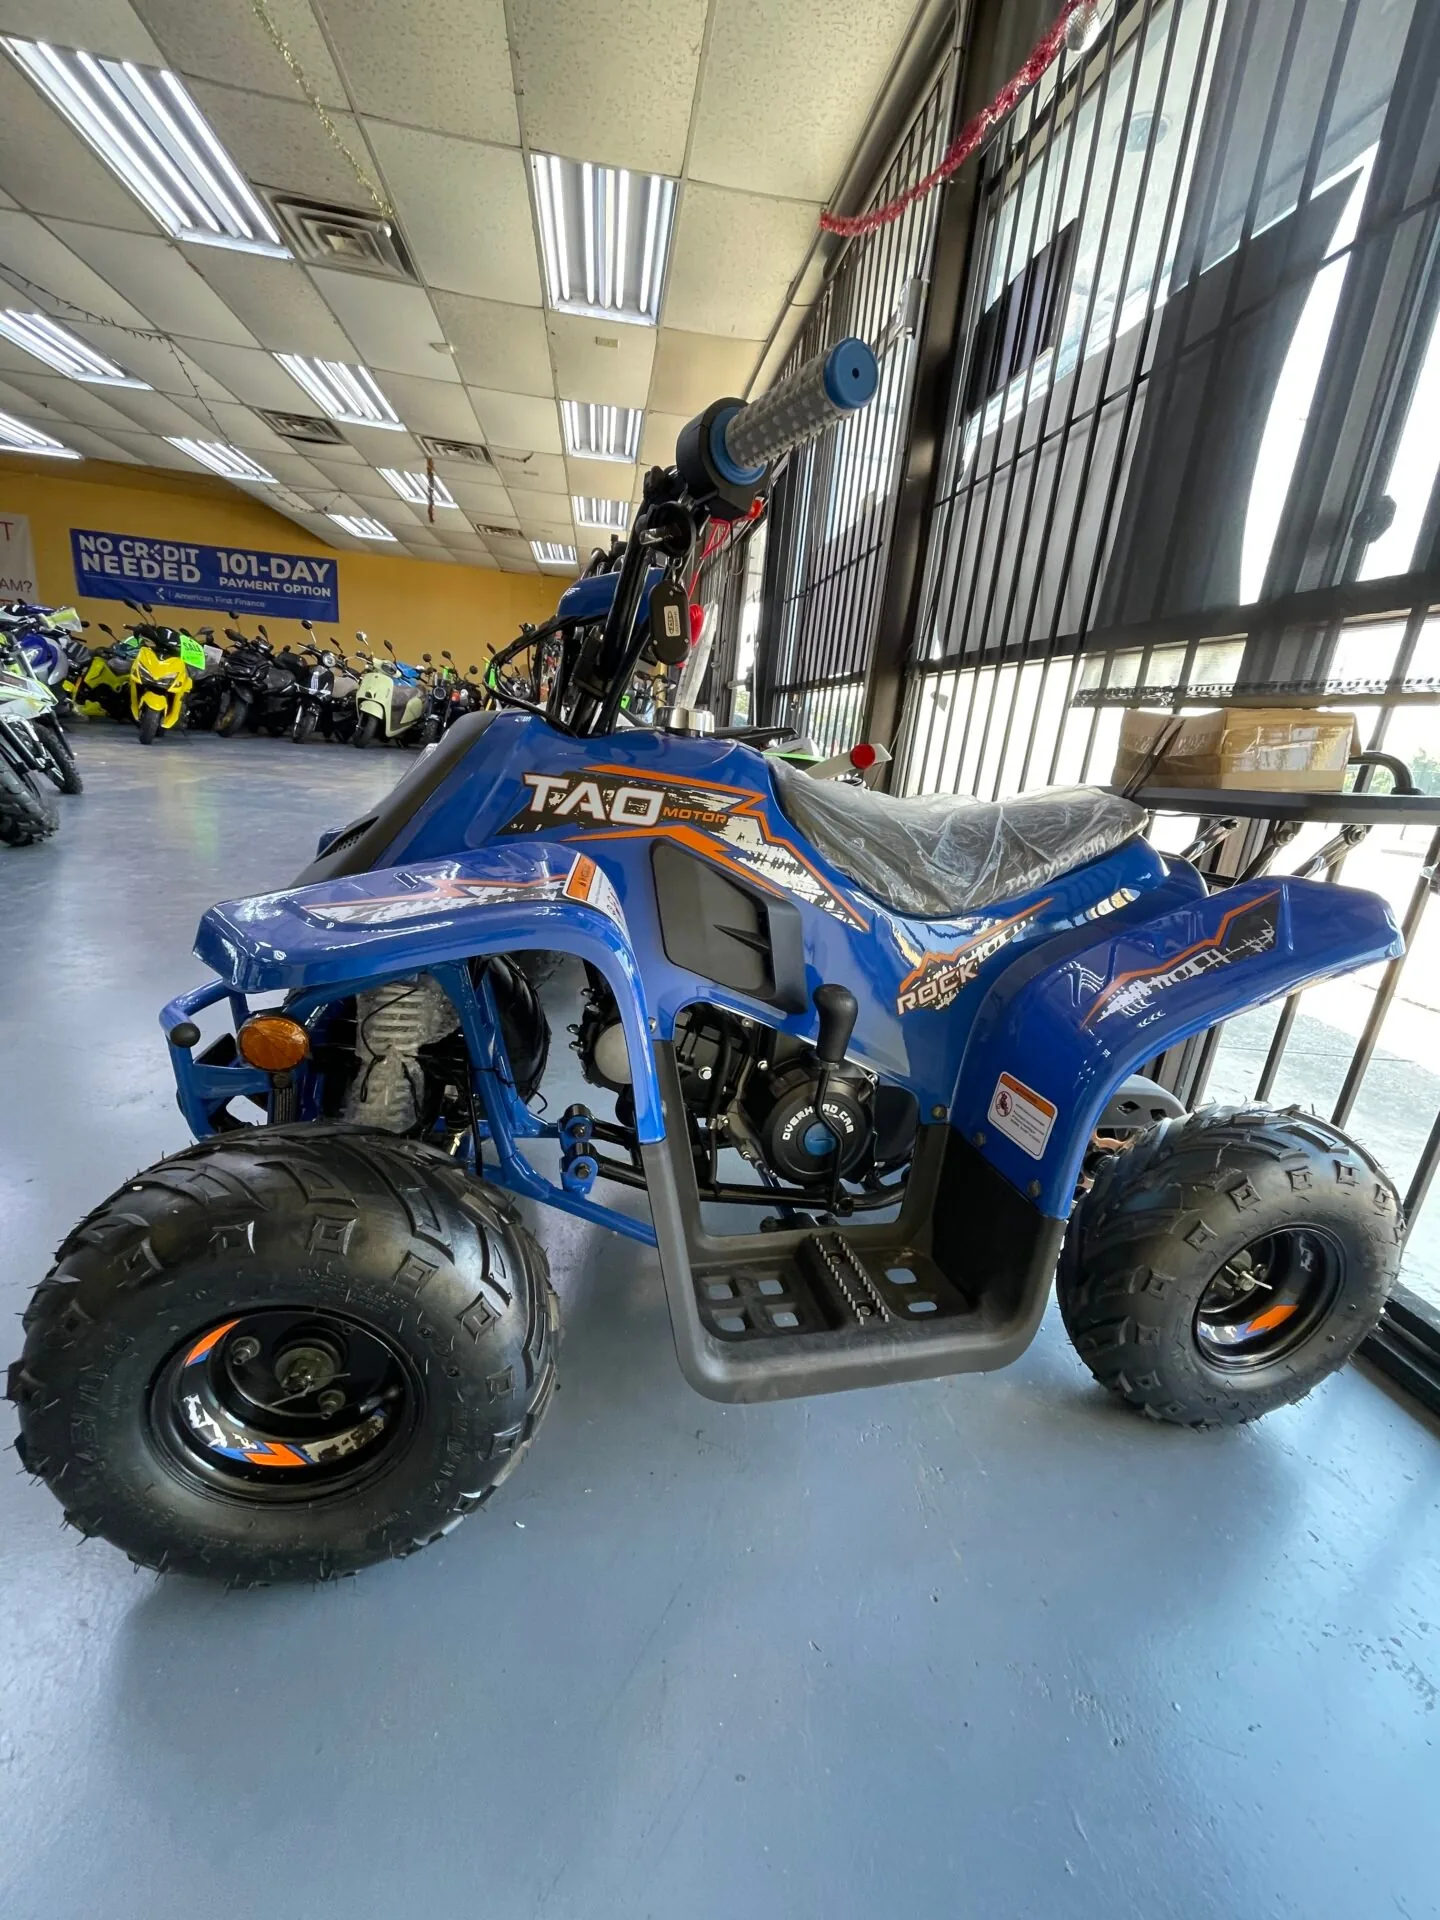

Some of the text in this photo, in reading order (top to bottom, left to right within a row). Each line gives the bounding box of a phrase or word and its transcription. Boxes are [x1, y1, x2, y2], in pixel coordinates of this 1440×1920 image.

[78, 534, 113, 553] NO
[81, 552, 201, 583] NEEDED
[216, 551, 330, 583] 101-DAY
[218, 577, 331, 597] PAYMENT OPTION
[524, 774, 728, 827] TAO MOTOR
[896, 960, 979, 1015] ROCK
[782, 1103, 839, 1140] OVERHAD
